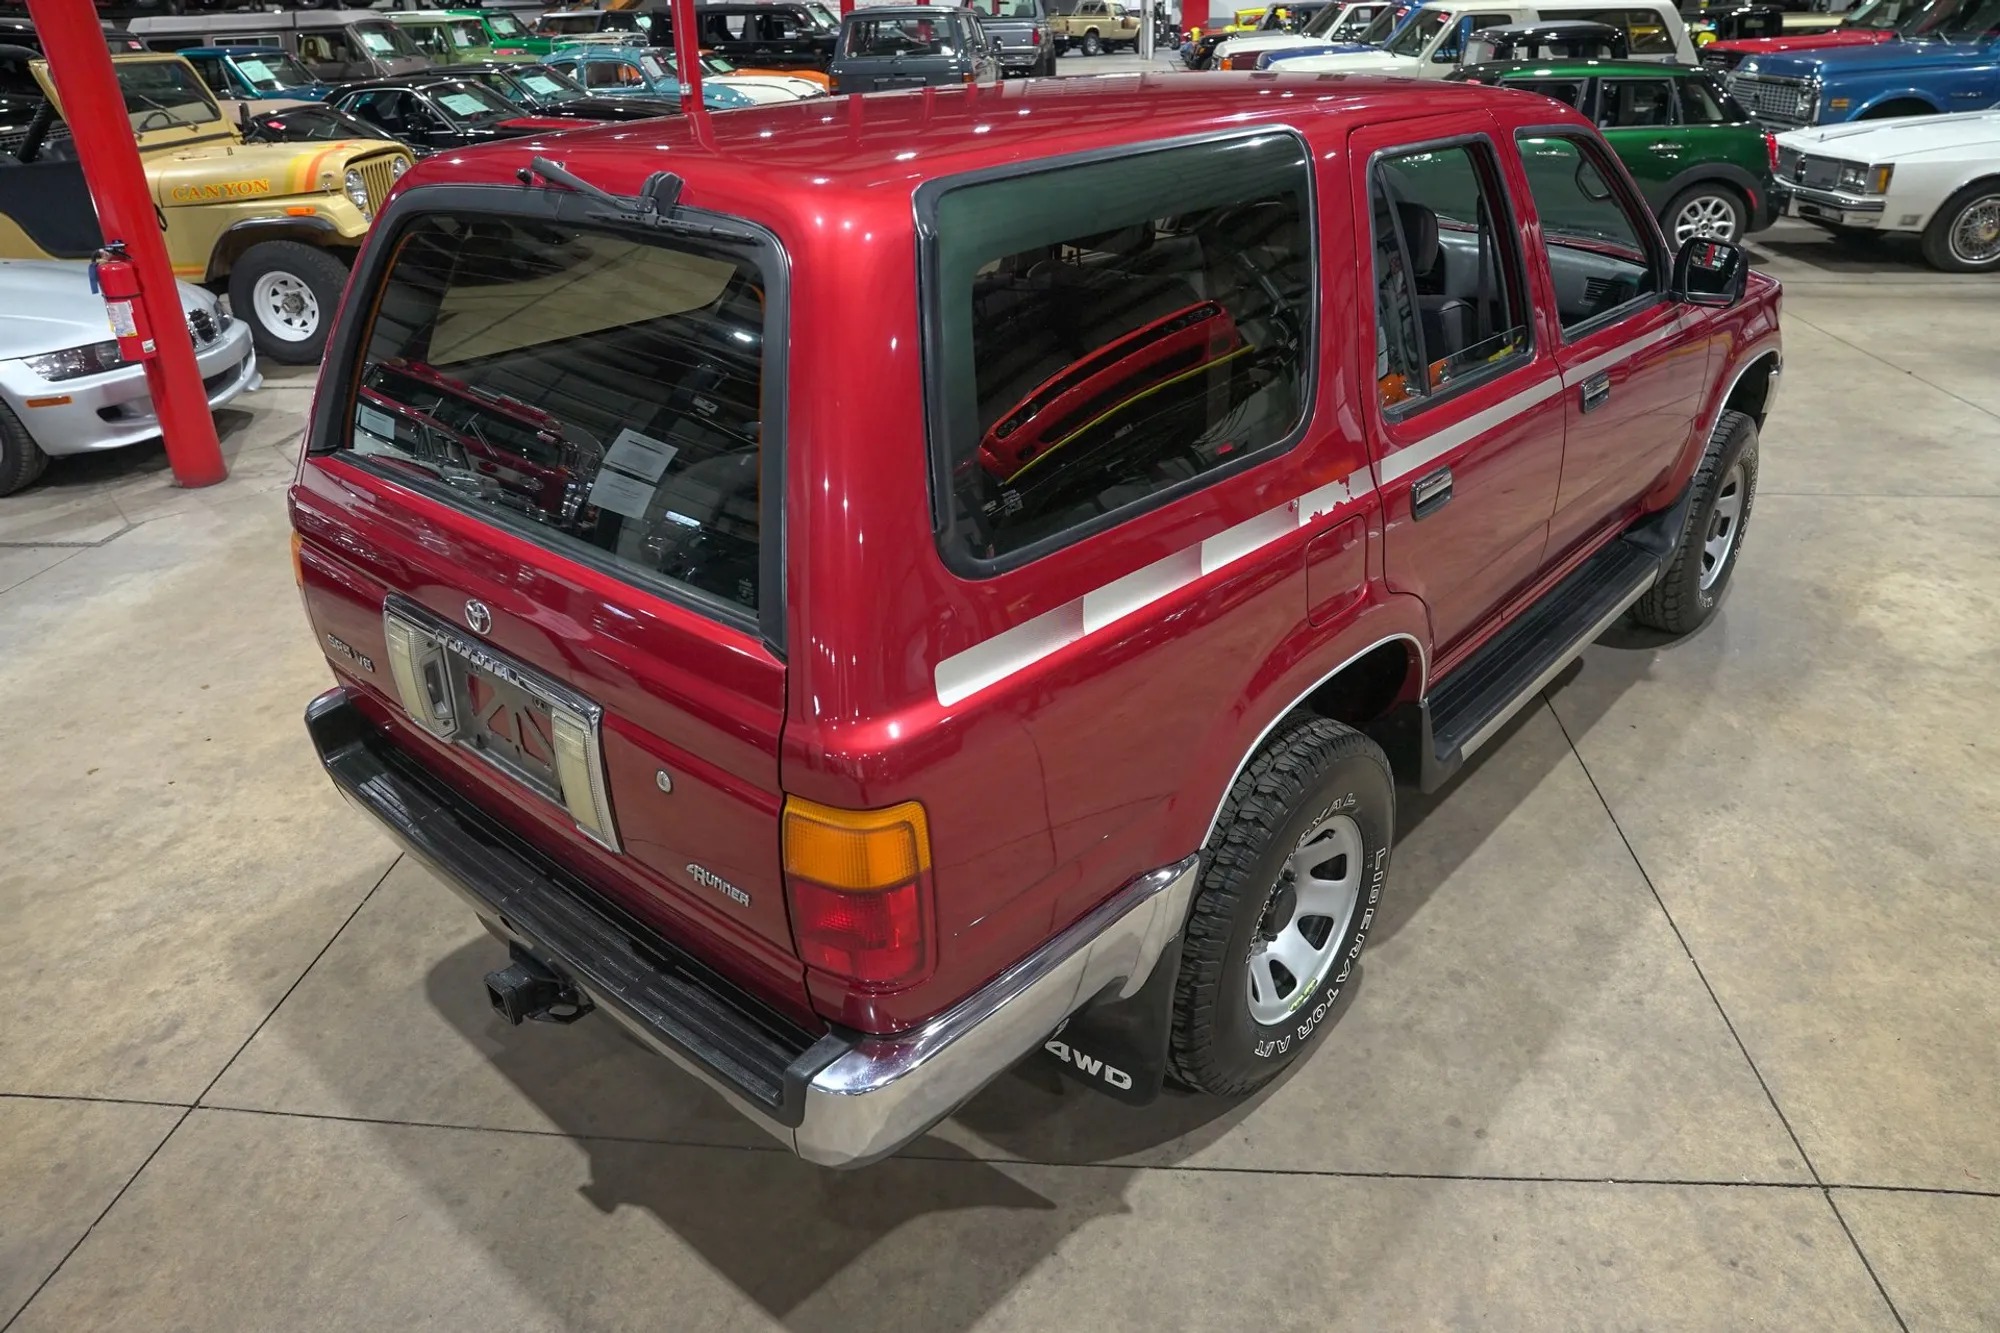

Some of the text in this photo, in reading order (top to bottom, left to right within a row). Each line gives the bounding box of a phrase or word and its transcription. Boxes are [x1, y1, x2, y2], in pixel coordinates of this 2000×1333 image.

[171, 179, 270, 202] CANYON
[1297, 847, 1386, 1041] LIBERATOR
[1044, 1040, 1133, 1090] 4WD
